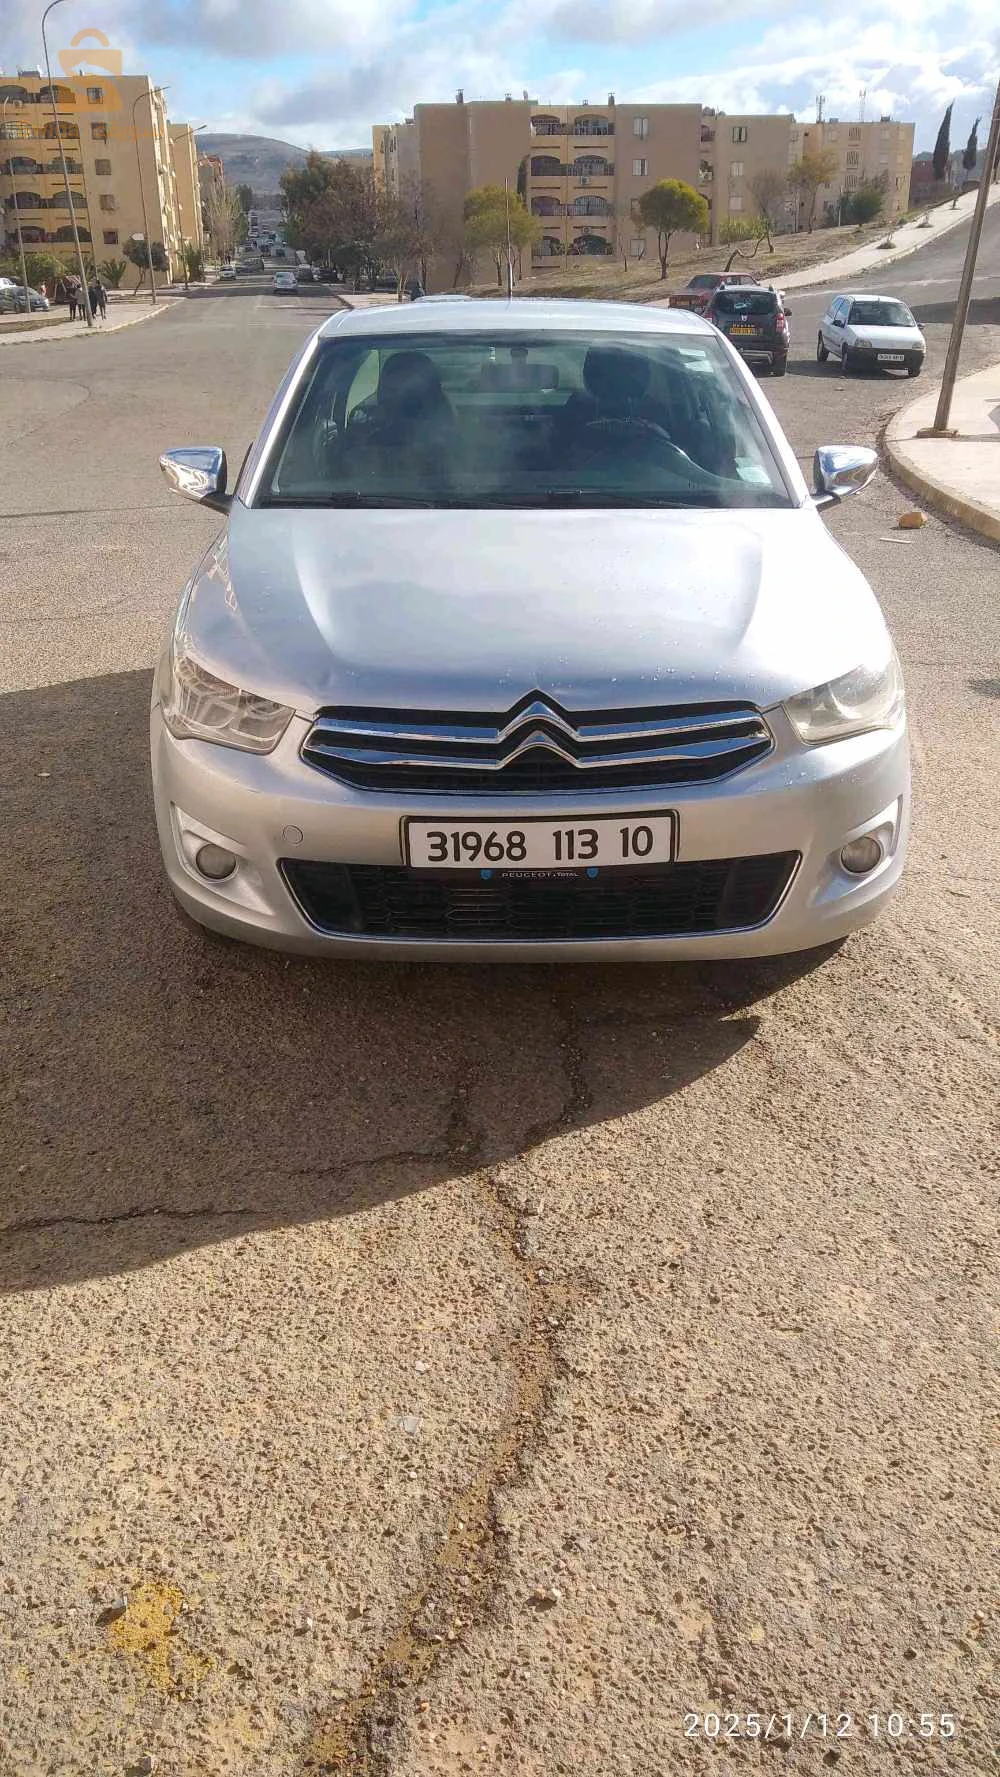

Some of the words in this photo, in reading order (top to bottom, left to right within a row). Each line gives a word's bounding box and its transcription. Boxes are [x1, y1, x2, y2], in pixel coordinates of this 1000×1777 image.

[426, 831, 527, 862] 31968
[552, 828, 599, 861] 113
[619, 825, 654, 858] 10
